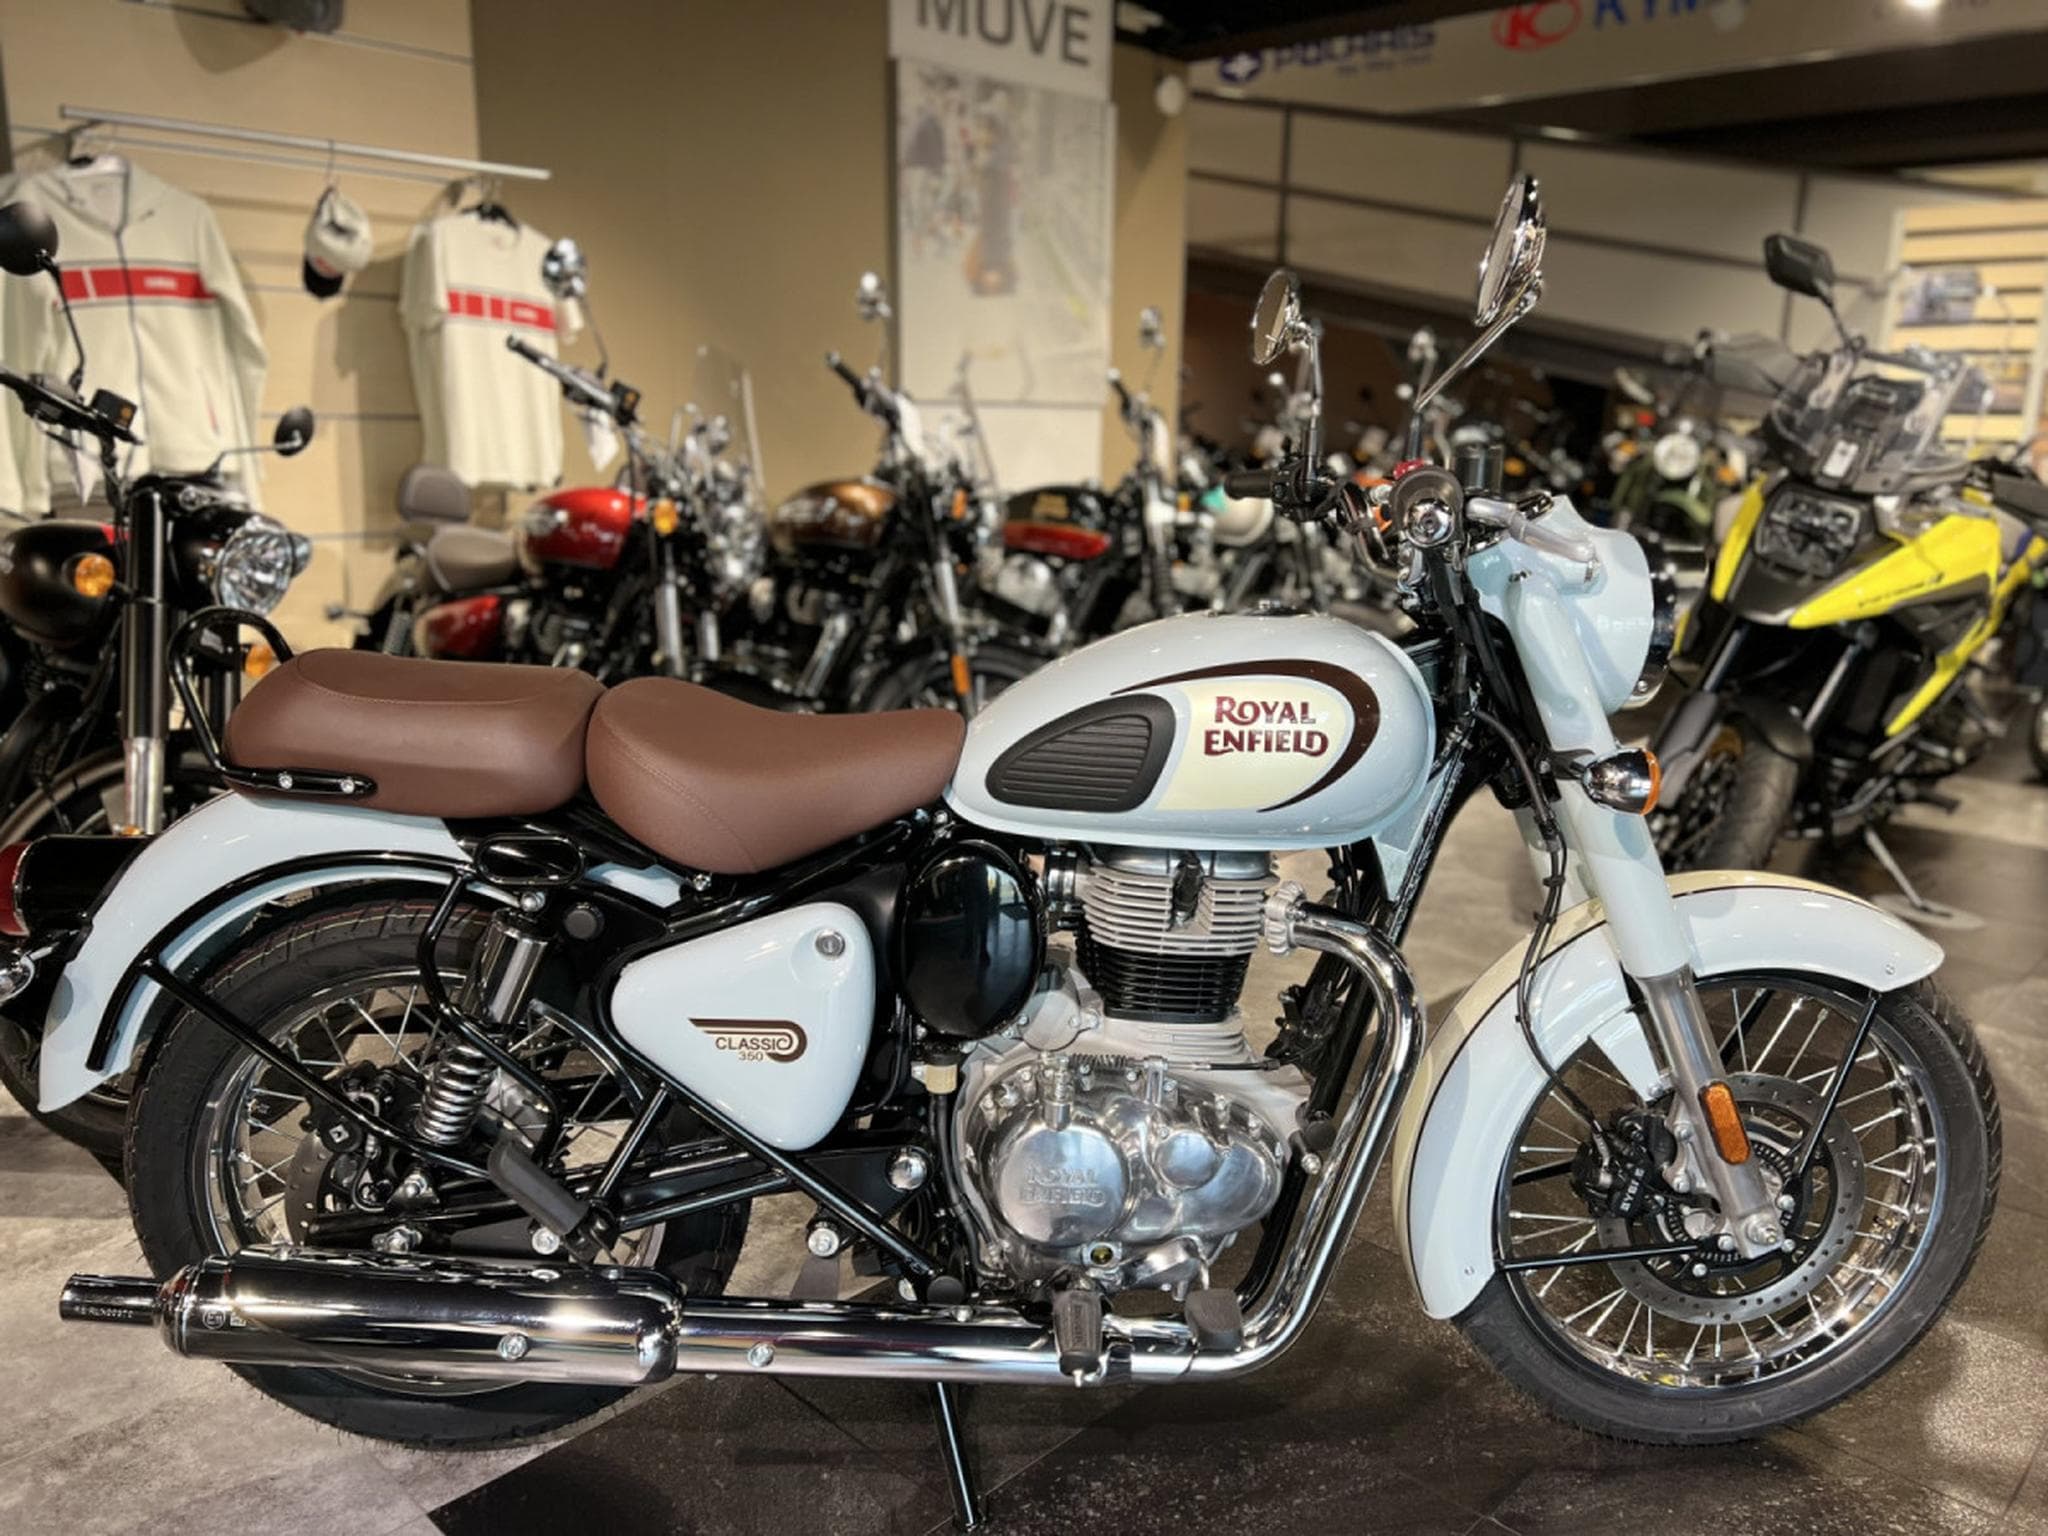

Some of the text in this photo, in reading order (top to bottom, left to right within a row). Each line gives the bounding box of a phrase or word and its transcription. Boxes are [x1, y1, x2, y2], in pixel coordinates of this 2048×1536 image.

[1215, 696, 1317, 726] ROYAL
[1204, 730, 1330, 757] ENFIELD
[715, 1036, 793, 1051] CLASSIC
